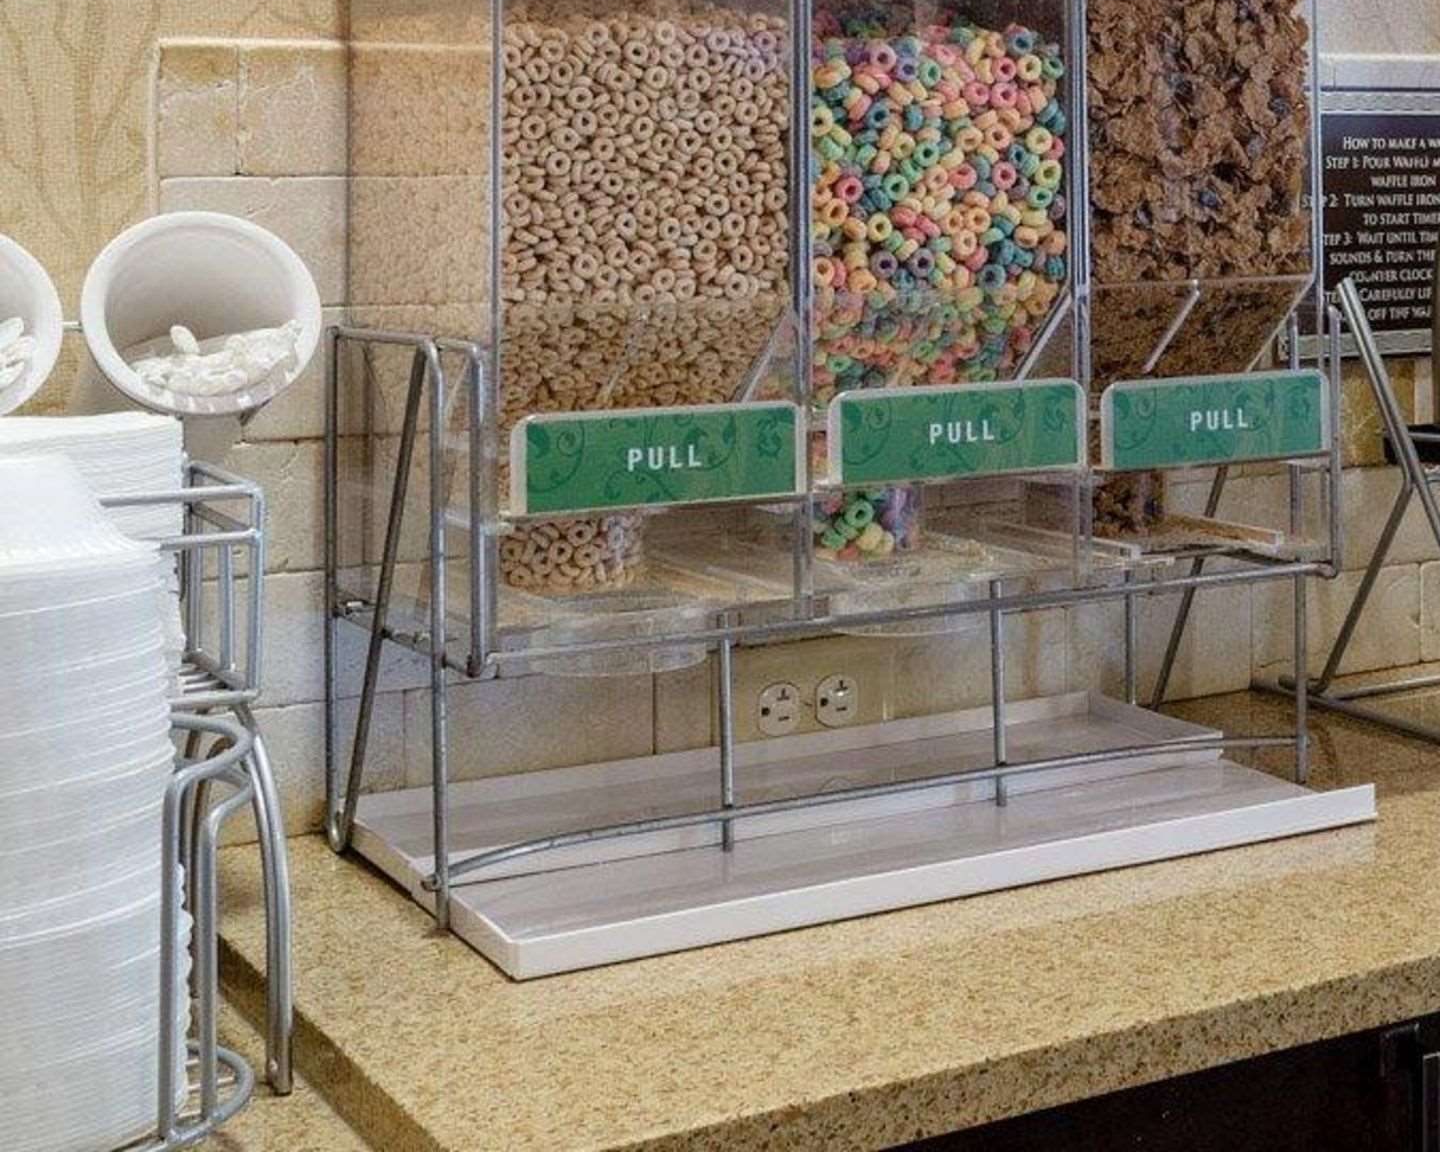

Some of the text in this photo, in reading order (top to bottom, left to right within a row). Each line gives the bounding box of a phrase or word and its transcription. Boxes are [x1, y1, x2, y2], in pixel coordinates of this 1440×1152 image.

[1322, 233, 1341, 246] TEP
[929, 419, 995, 446] PULL
[1190, 407, 1249, 432] PULL
[628, 444, 703, 473] PULL
